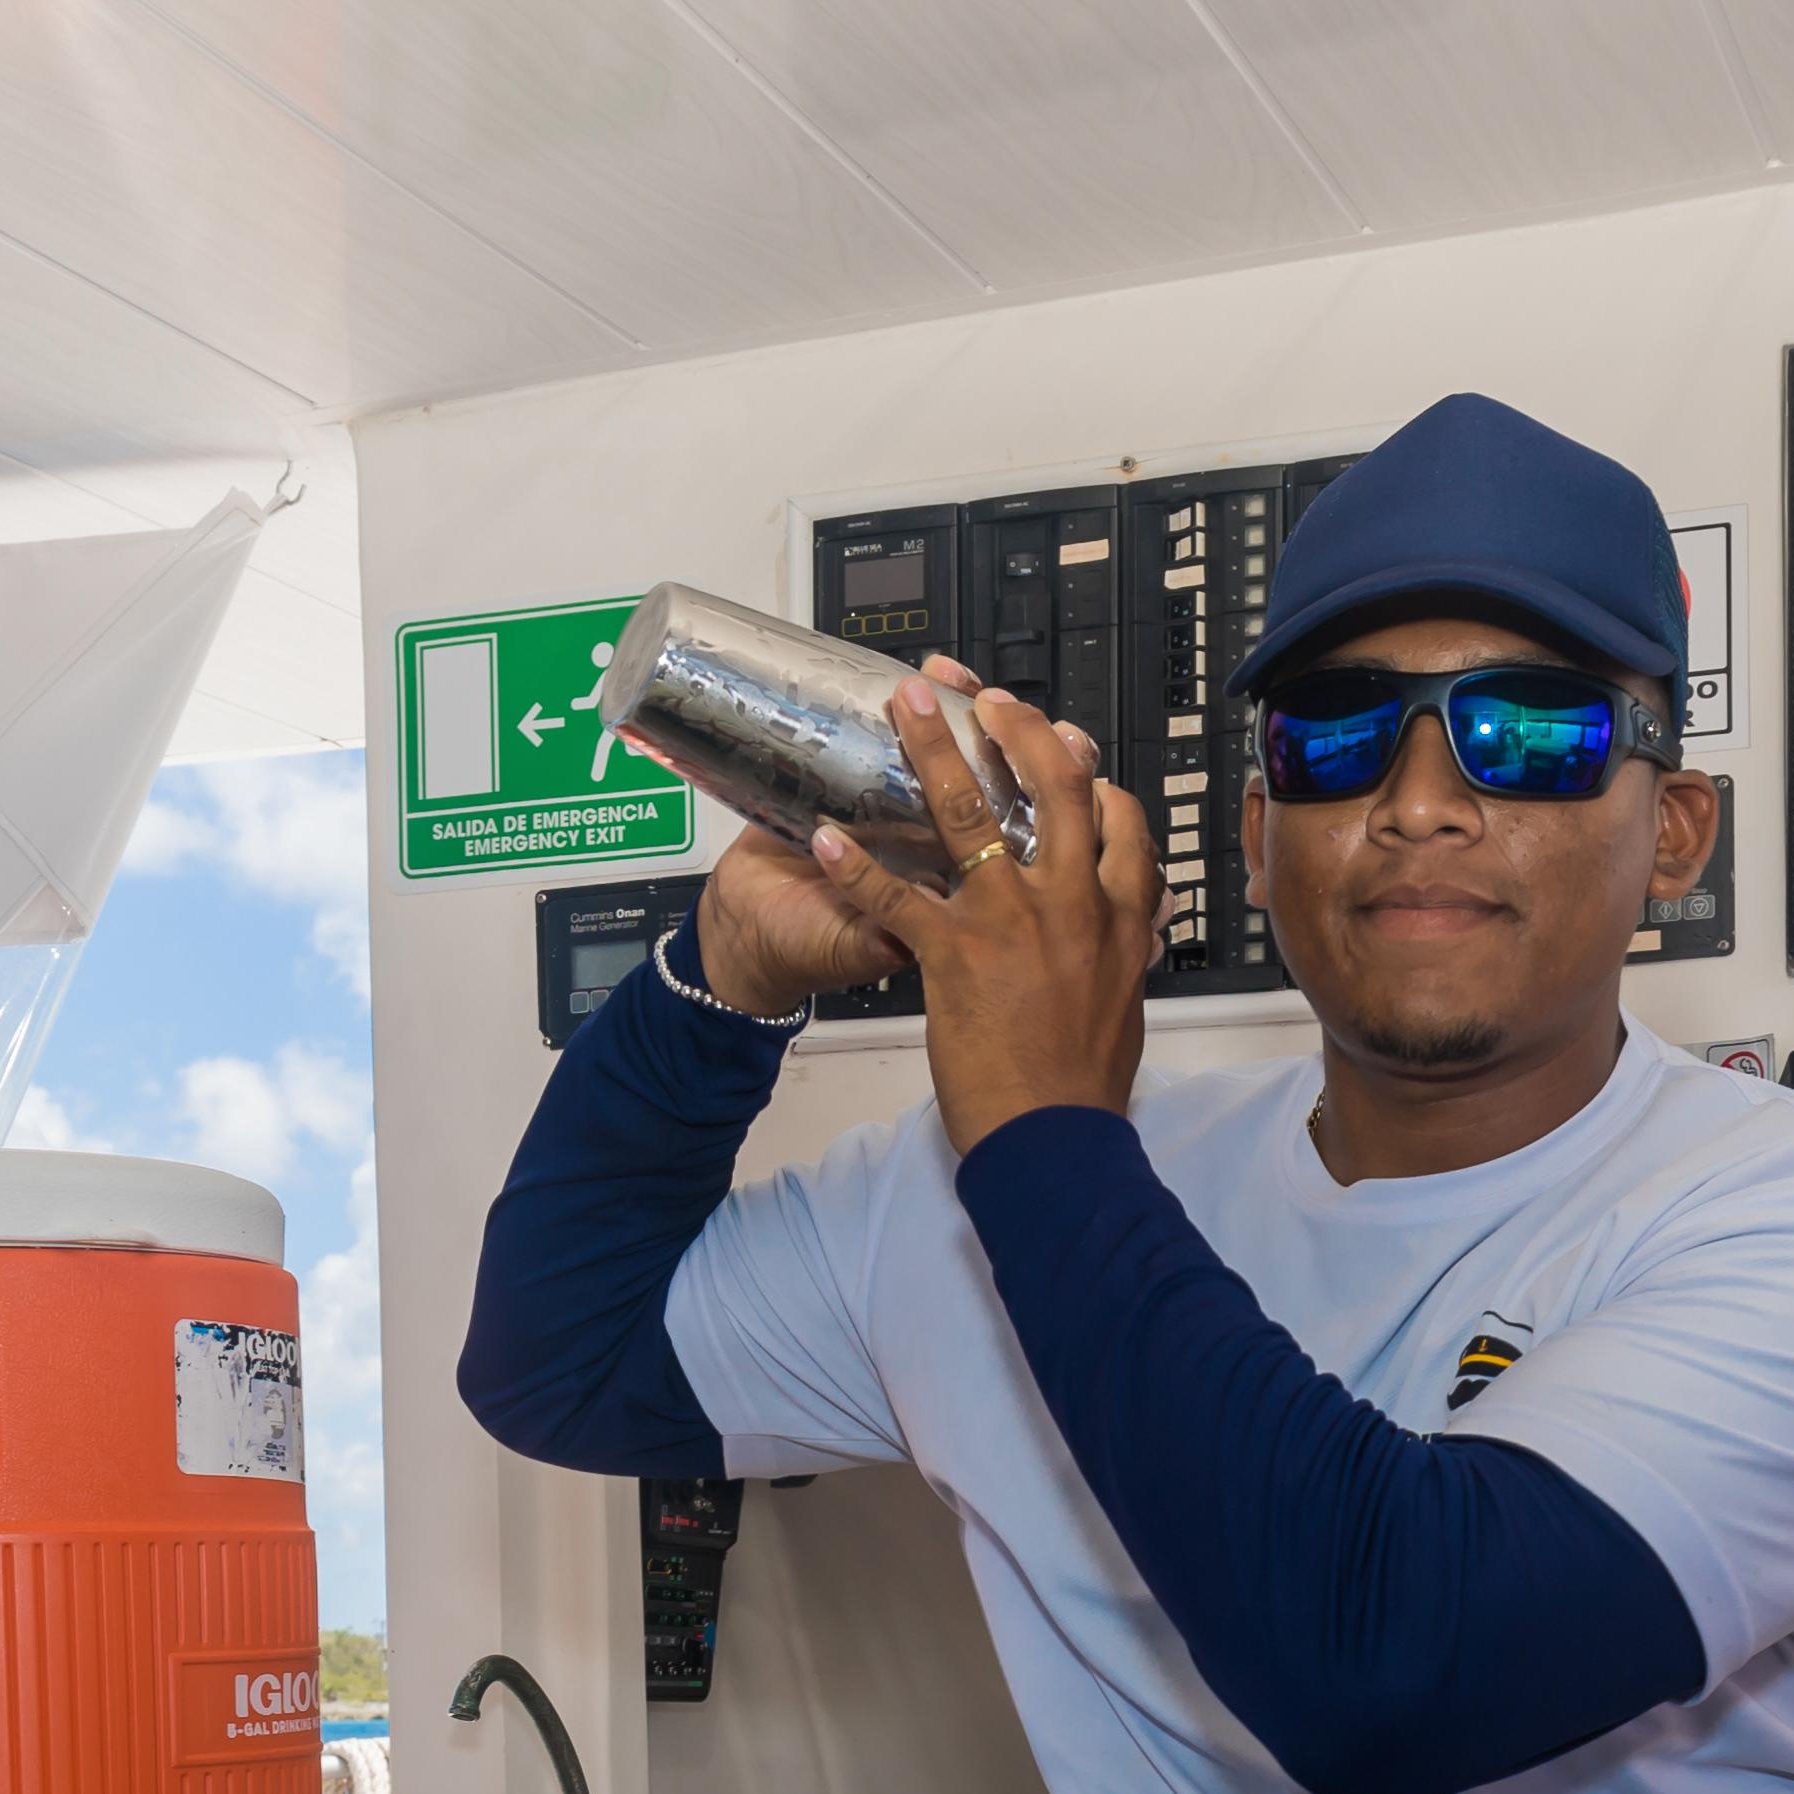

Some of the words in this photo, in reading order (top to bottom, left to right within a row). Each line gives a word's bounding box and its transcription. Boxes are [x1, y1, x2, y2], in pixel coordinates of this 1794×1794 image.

[903, 539, 924, 551] M2
[432, 818, 498, 840] SALIDA
[504, 814, 527, 832] DE
[533, 802, 658, 830] EMERGENCIA
[464, 830, 579, 857] EMERGENCY
[586, 826, 626, 846] EXIT
[570, 911, 614, 924] Cummins
[616, 908, 645, 919] Onan
[570, 924, 598, 933] Marine
[599, 920, 639, 931] Generator
[238, 1331, 296, 1367] IGLOO
[272, 1717, 312, 1734] DRINKING
